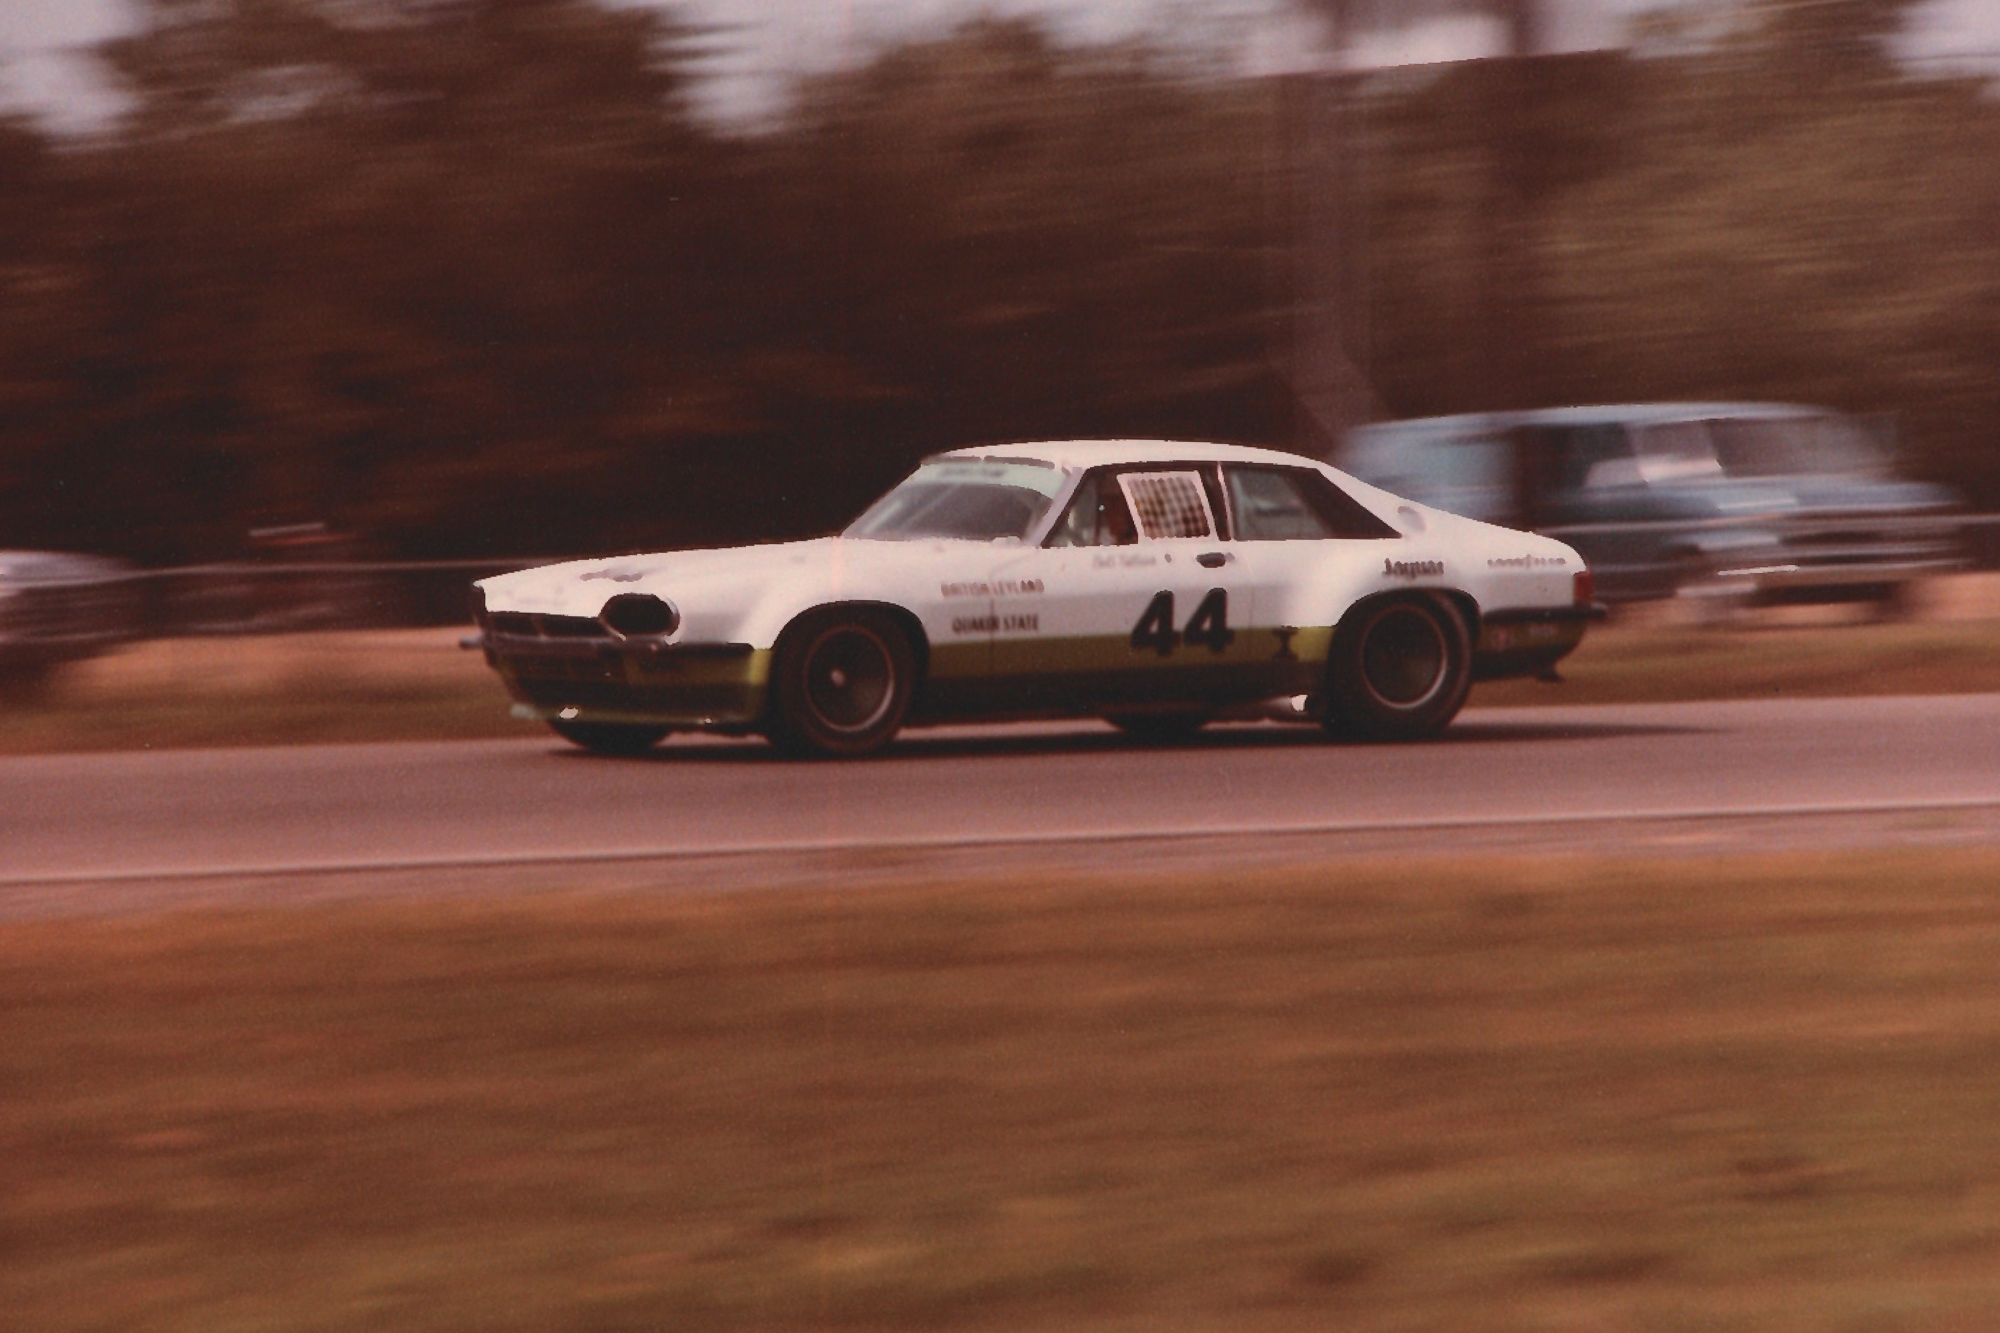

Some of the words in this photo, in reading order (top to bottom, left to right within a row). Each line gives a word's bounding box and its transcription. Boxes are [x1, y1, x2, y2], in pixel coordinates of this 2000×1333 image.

[951, 615, 1000, 634] QUAKER
[1003, 613, 1039, 632] STATE
[1131, 587, 1235, 656] 44
